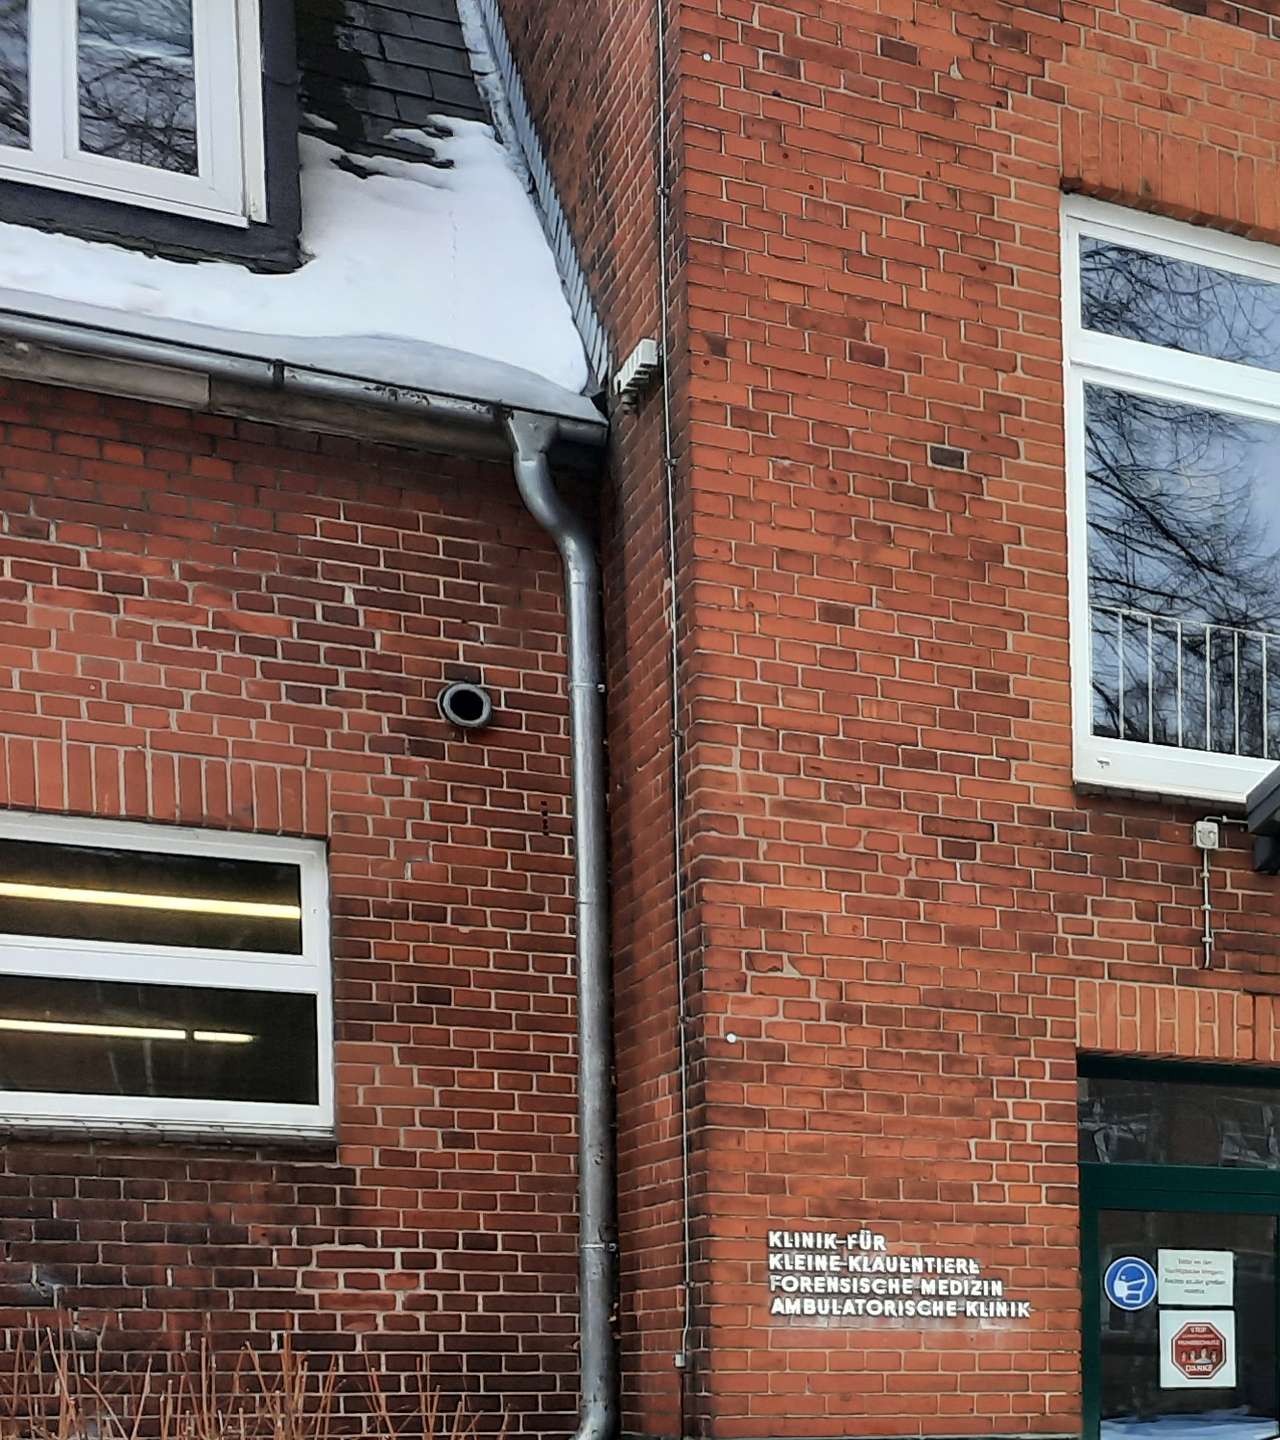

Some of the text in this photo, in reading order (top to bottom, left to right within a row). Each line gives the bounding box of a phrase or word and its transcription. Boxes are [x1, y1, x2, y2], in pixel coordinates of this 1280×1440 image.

[768, 1229, 886, 1250] KLINIK FÜR
[769, 1254, 980, 1274] KLEINE KLAUENTIERE
[770, 1276, 1003, 1297] FORENSISCHE MEDIZIN
[770, 1298, 1031, 1317] AMBULATORISCHE KLINIK
